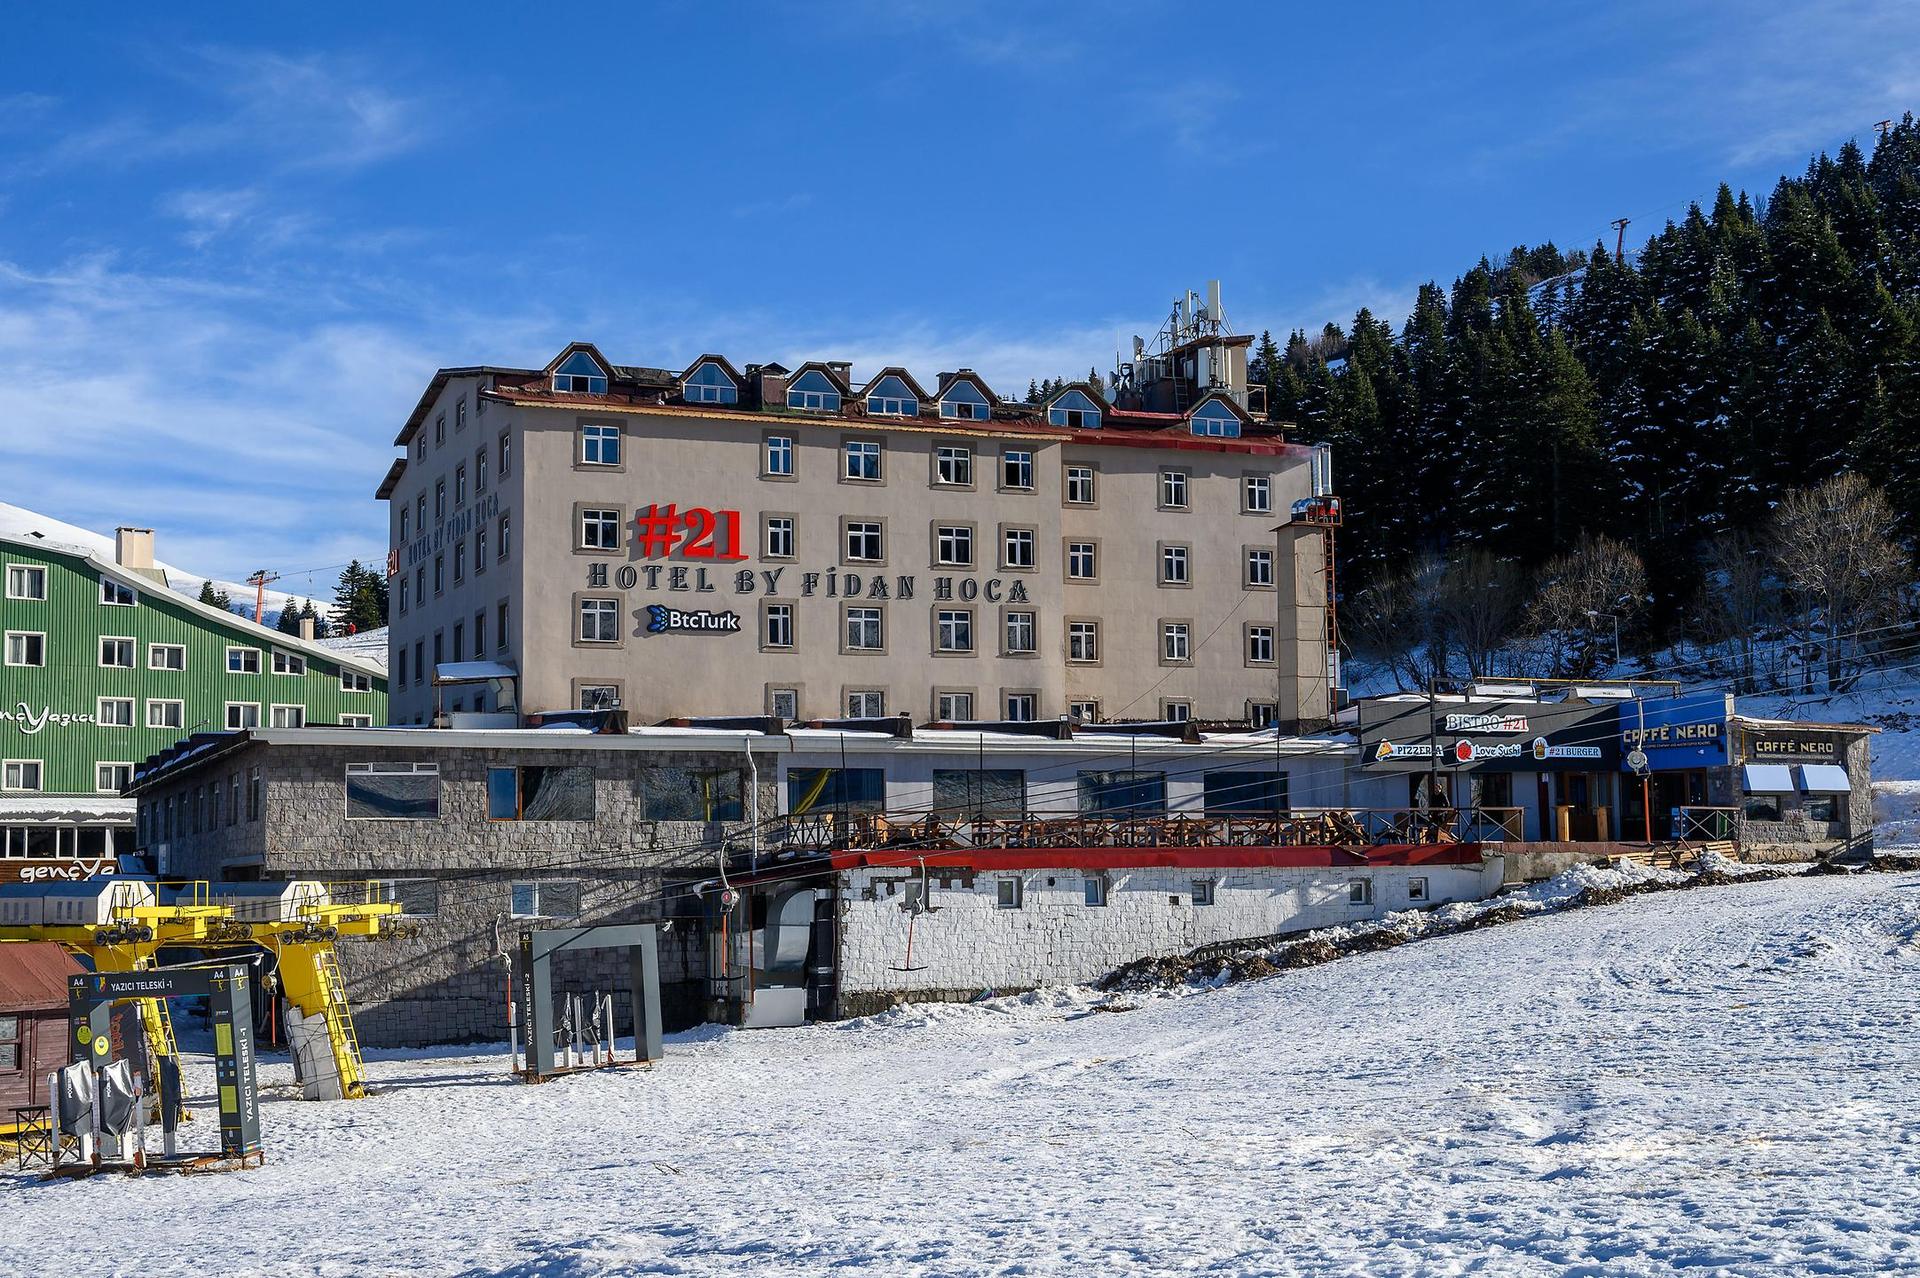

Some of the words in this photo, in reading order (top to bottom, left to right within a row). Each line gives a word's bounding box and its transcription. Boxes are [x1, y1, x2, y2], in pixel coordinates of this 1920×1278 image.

[638, 503, 749, 559] #21
[587, 563, 717, 593] HOTEL
[734, 566, 786, 596] BY
[932, 577, 1031, 603] HOCA
[670, 611, 738, 630] BtcTurk
[1448, 716, 1500, 730] BISTRO
[1503, 717, 1528, 730] #21
[1676, 723, 1718, 740] NERO
[1397, 746, 1442, 755] PIZZERA
[1475, 745, 1496, 755] Love
[1498, 745, 1521, 756] Sushi
[1549, 748, 1564, 756] #21
[1566, 747, 1599, 756] BURGER
[1800, 742, 1833, 753] NERO
[214, 971, 224, 979] A4
[235, 968, 244, 977] A4
[73, 978, 84, 986] A4
[110, 982, 135, 991] YAZICI
[244, 1085, 254, 1123] YAZICI
